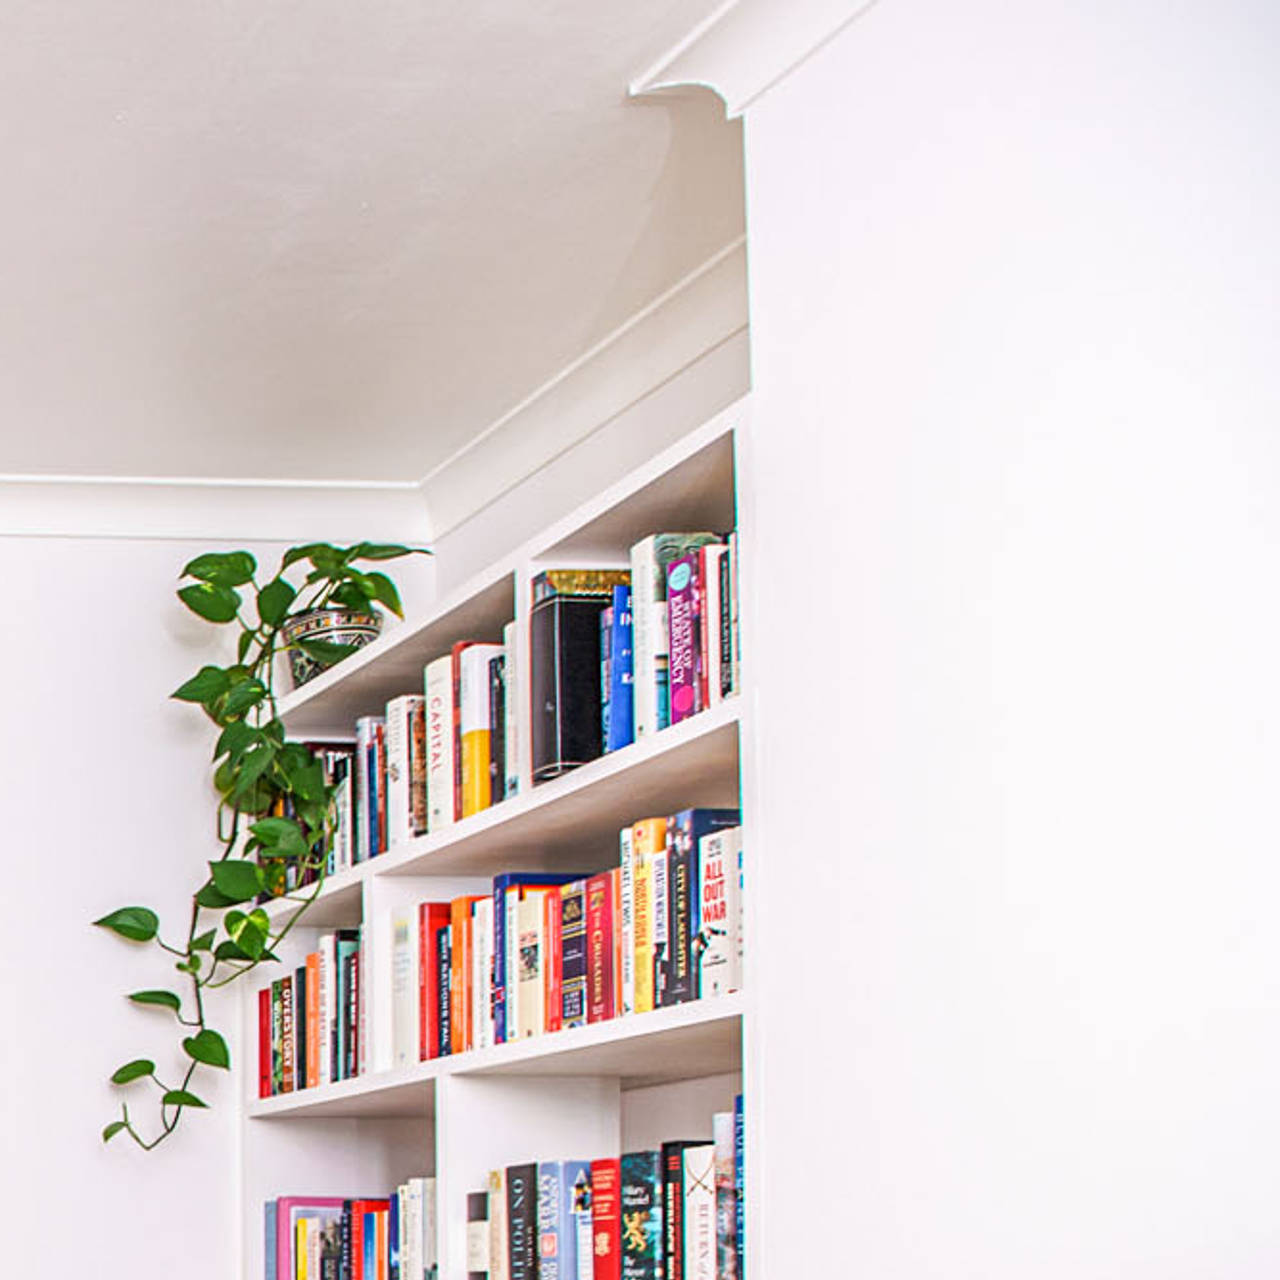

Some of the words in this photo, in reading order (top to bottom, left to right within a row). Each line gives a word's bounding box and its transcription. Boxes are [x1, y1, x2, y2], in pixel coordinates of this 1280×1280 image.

[671, 595, 685, 685] EMERGENCY
[430, 698, 442, 777] CAPITAL
[704, 860, 723, 880] ALL
[702, 901, 726, 923] WAR
[703, 880, 725, 903] OUT
[283, 989, 292, 1066] OVERSTORY
[513, 1178, 527, 1210] ON
[698, 1204, 709, 1257] RETURN
